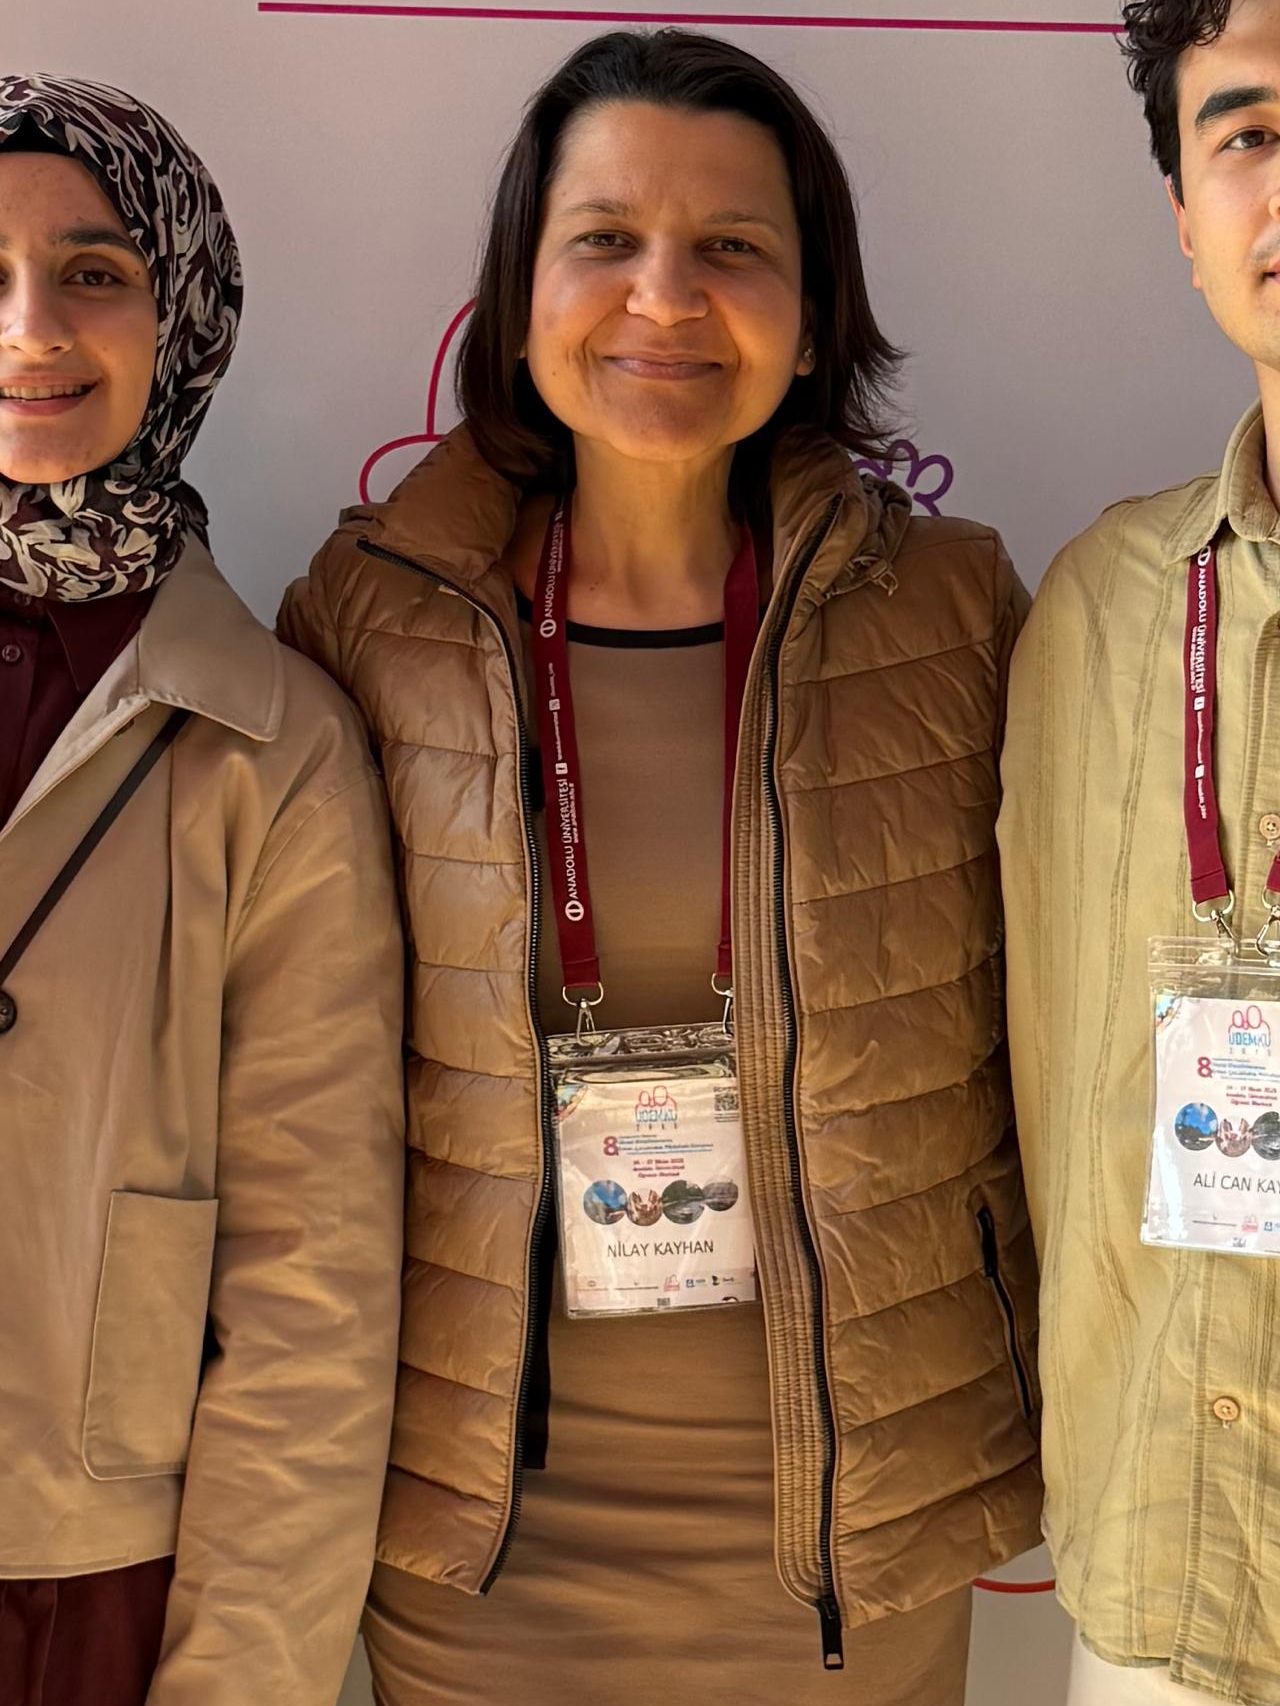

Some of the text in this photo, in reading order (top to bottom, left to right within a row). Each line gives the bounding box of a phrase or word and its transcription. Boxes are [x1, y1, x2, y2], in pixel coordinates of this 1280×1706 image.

[564, 845, 579, 900] ANADOLU
[1193, 1171, 1216, 1190] ALİ
[1220, 1174, 1252, 1193] CAN
[607, 1240, 715, 1259] NİLAY KAYHAN
